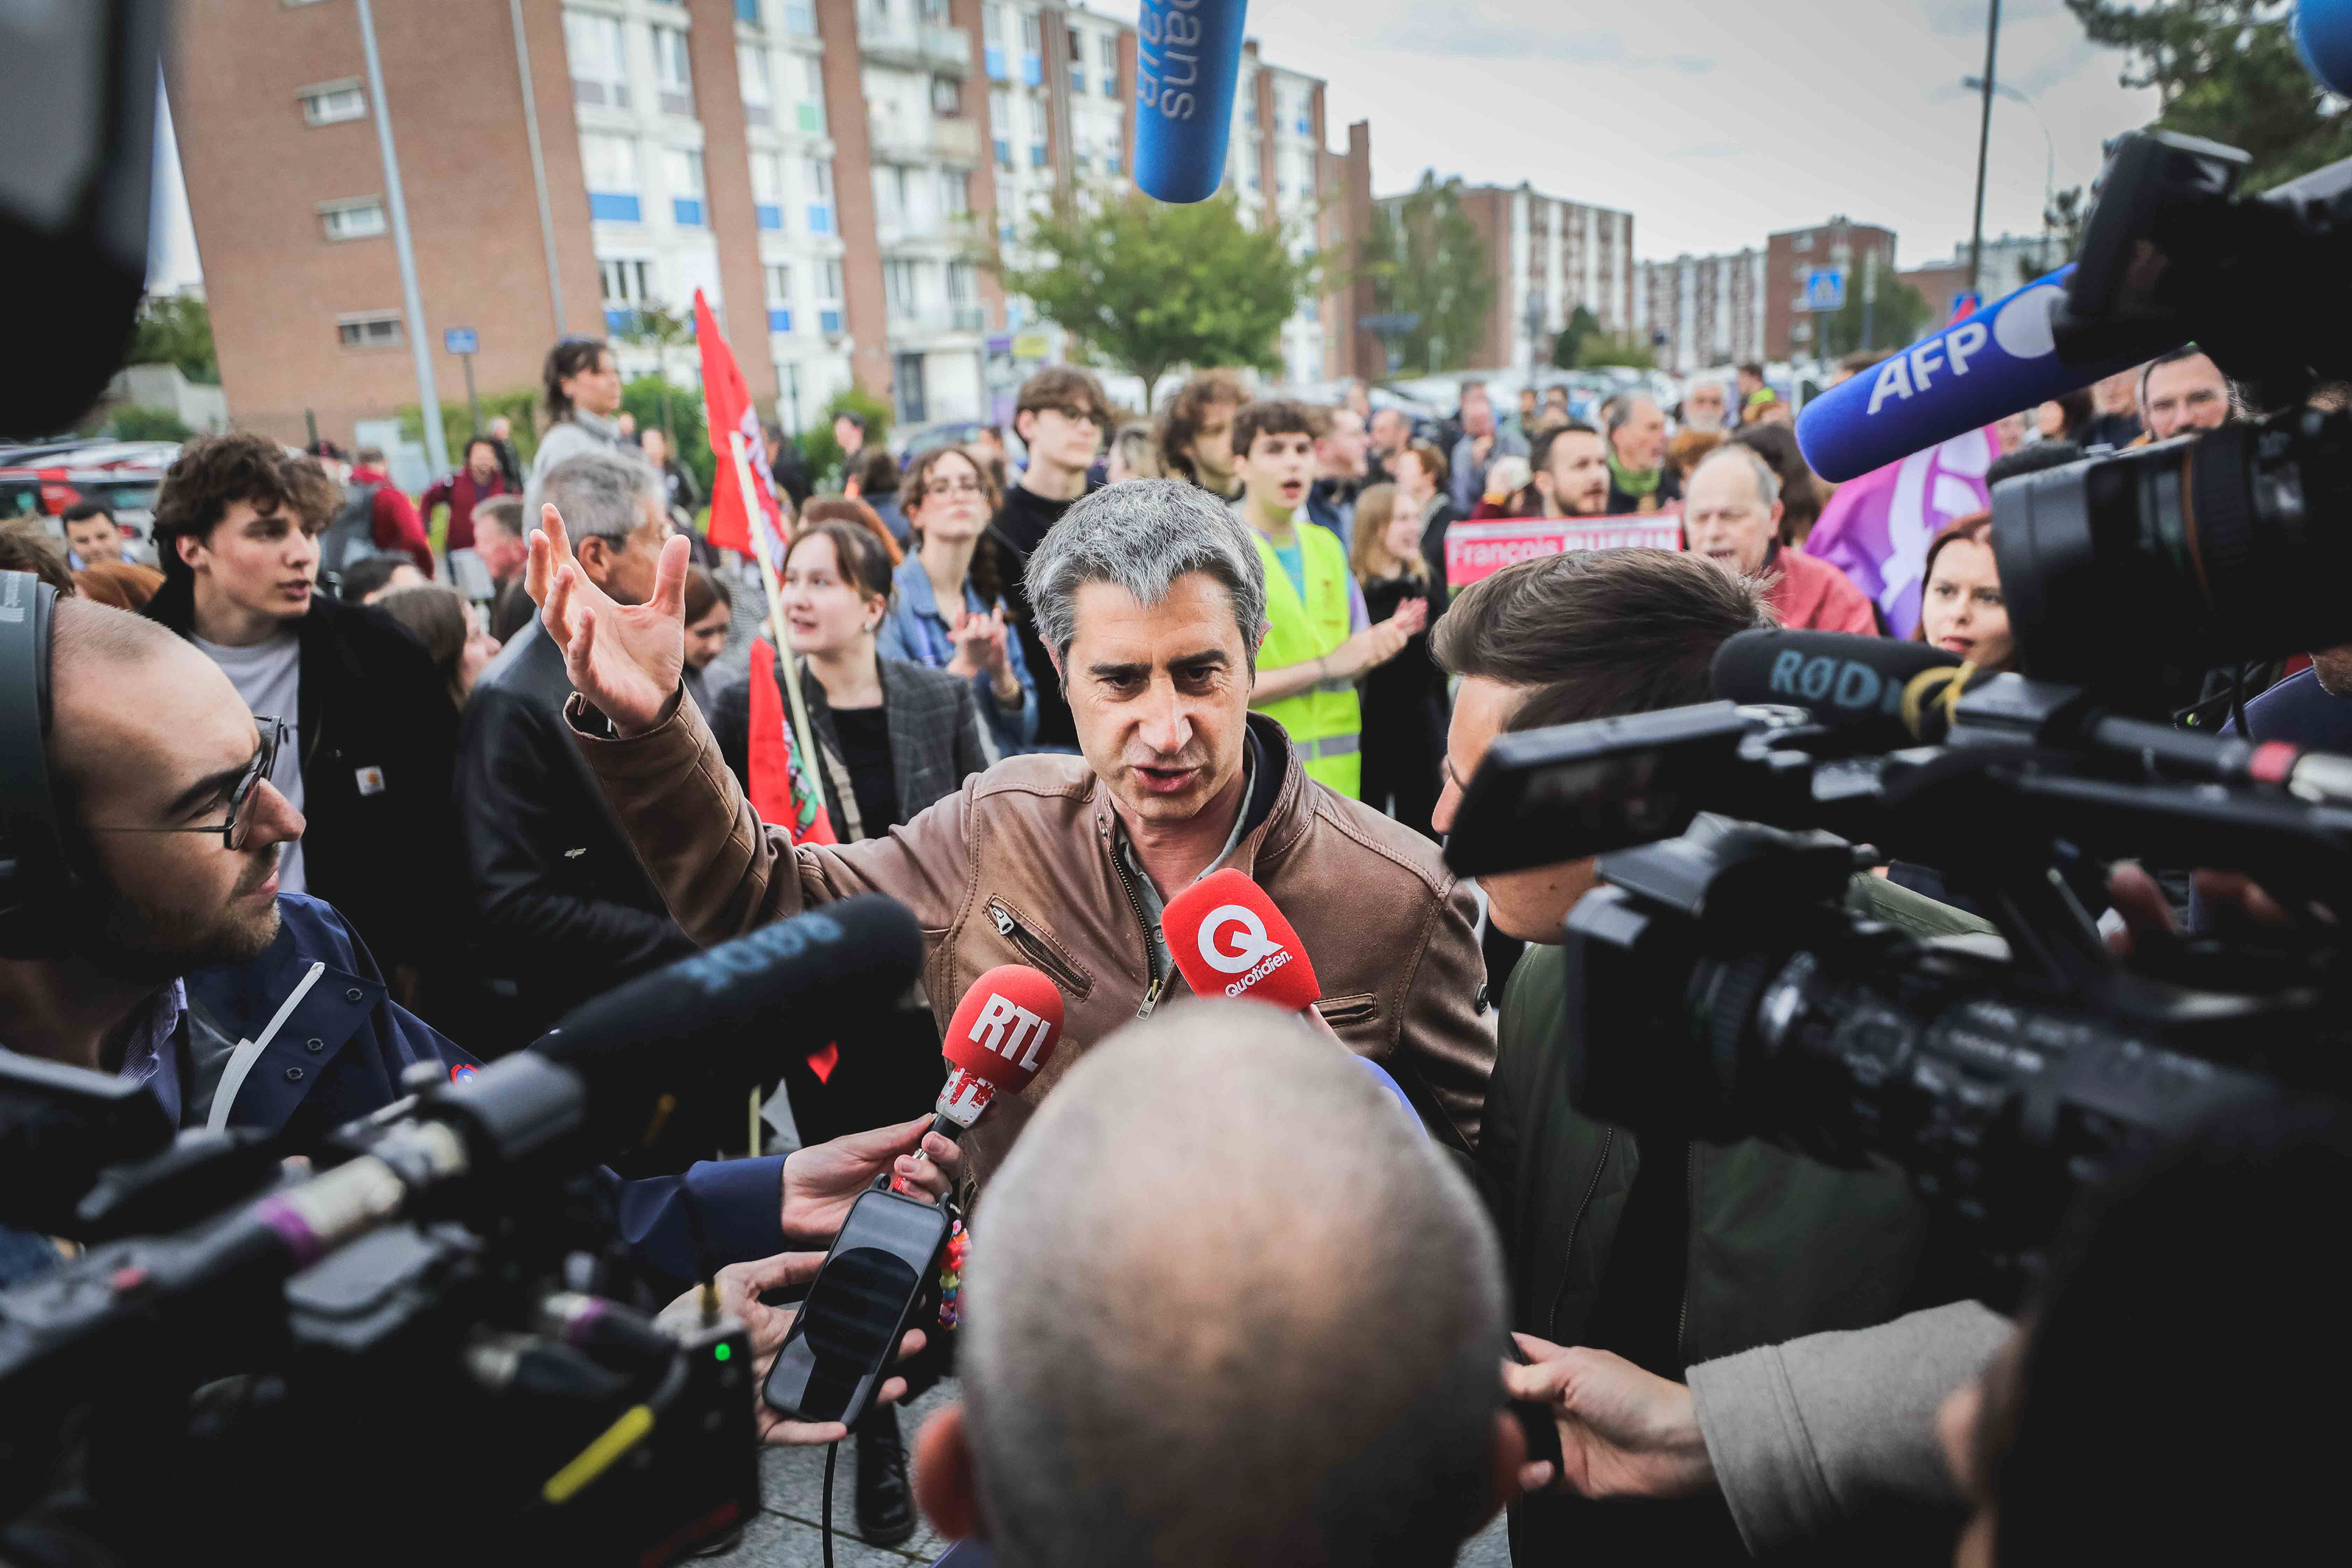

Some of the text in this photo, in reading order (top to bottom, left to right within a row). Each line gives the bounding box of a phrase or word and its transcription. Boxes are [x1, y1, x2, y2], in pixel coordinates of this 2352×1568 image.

[1867, 322, 1988, 415] AFP
[1448, 535, 1558, 567] François
[968, 993, 1051, 1072] RTL
